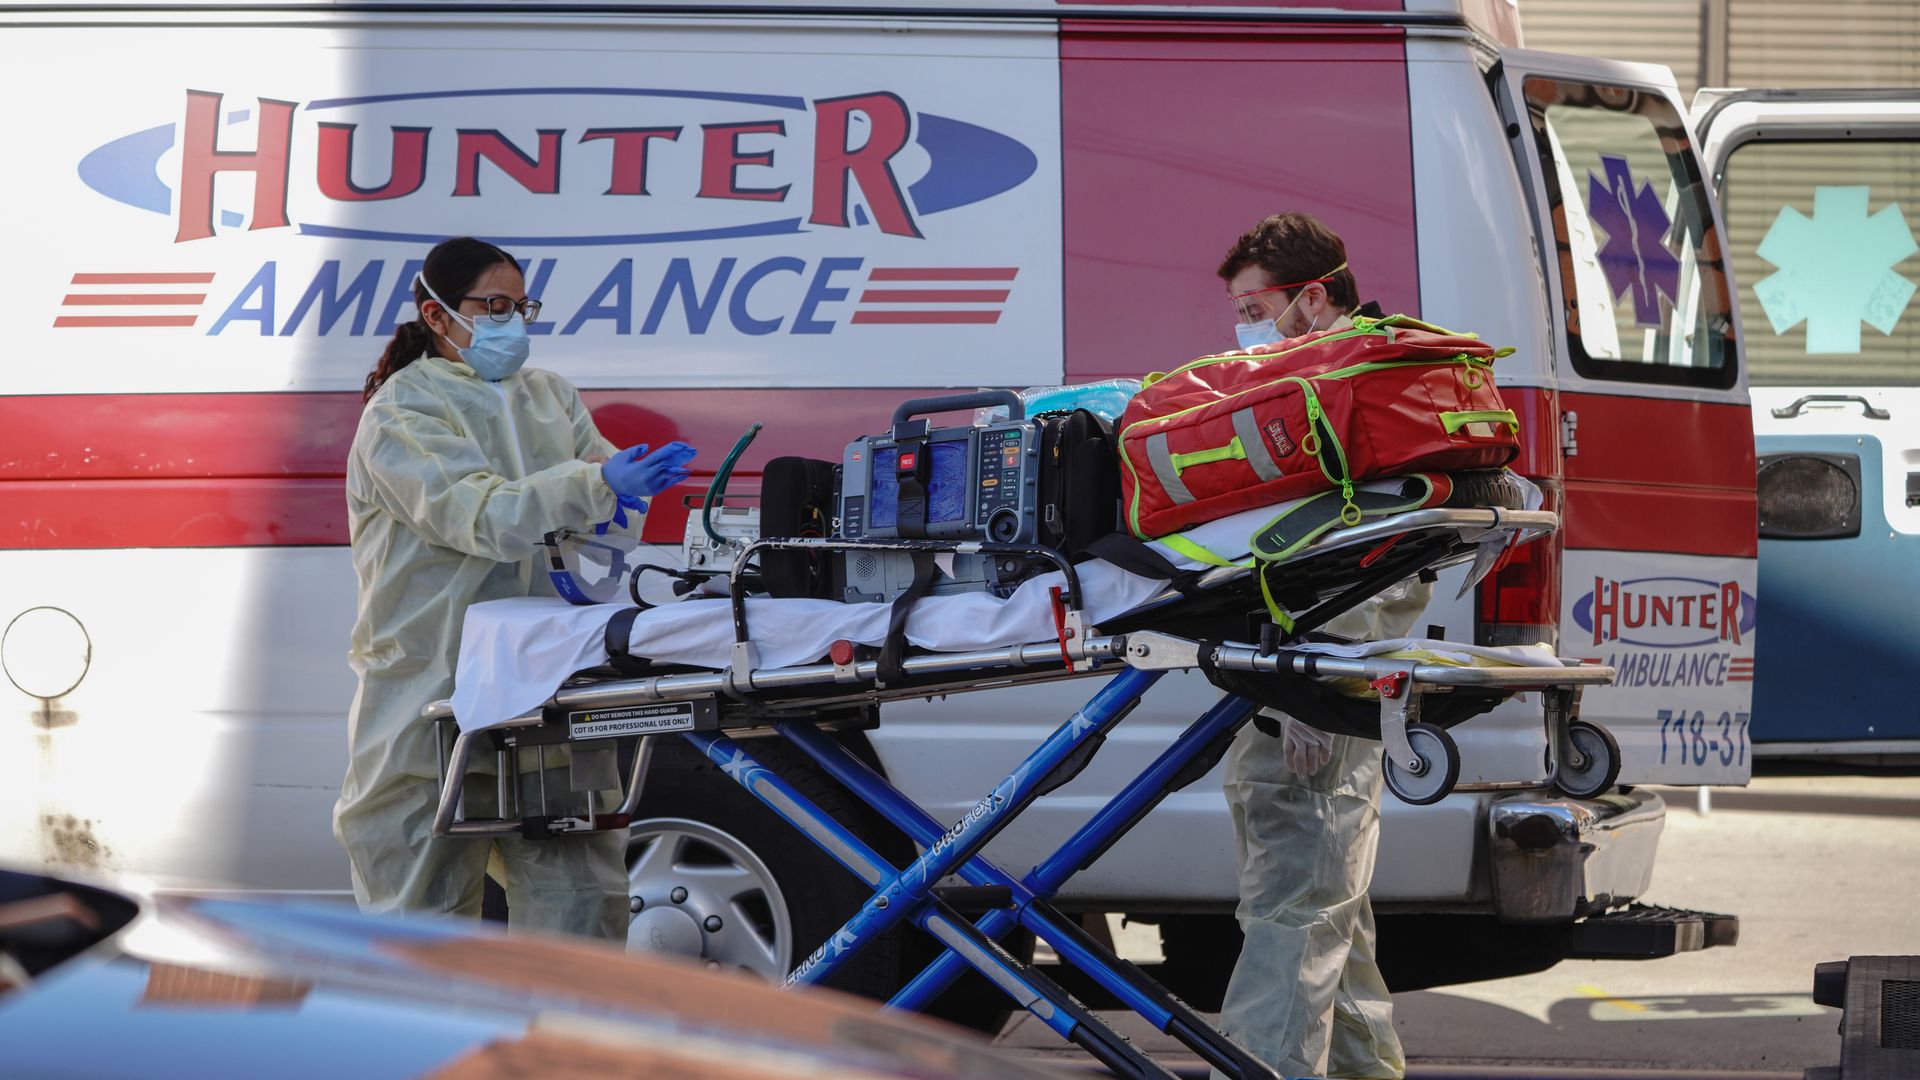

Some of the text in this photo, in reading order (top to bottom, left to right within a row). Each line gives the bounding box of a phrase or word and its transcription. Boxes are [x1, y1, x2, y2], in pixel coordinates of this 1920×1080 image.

[174, 88, 926, 243] HUNTER
[205, 256, 865, 336] AMLANCE
[1593, 576, 1741, 647] HUNTER
[574, 726, 587, 734] COT
[595, 724, 608, 732] FOR
[609, 720, 657, 730] PROFESSIONAL
[658, 719, 671, 727] USE
[672, 717, 690, 725] ONLY
[1656, 709, 1750, 767] 718-37
